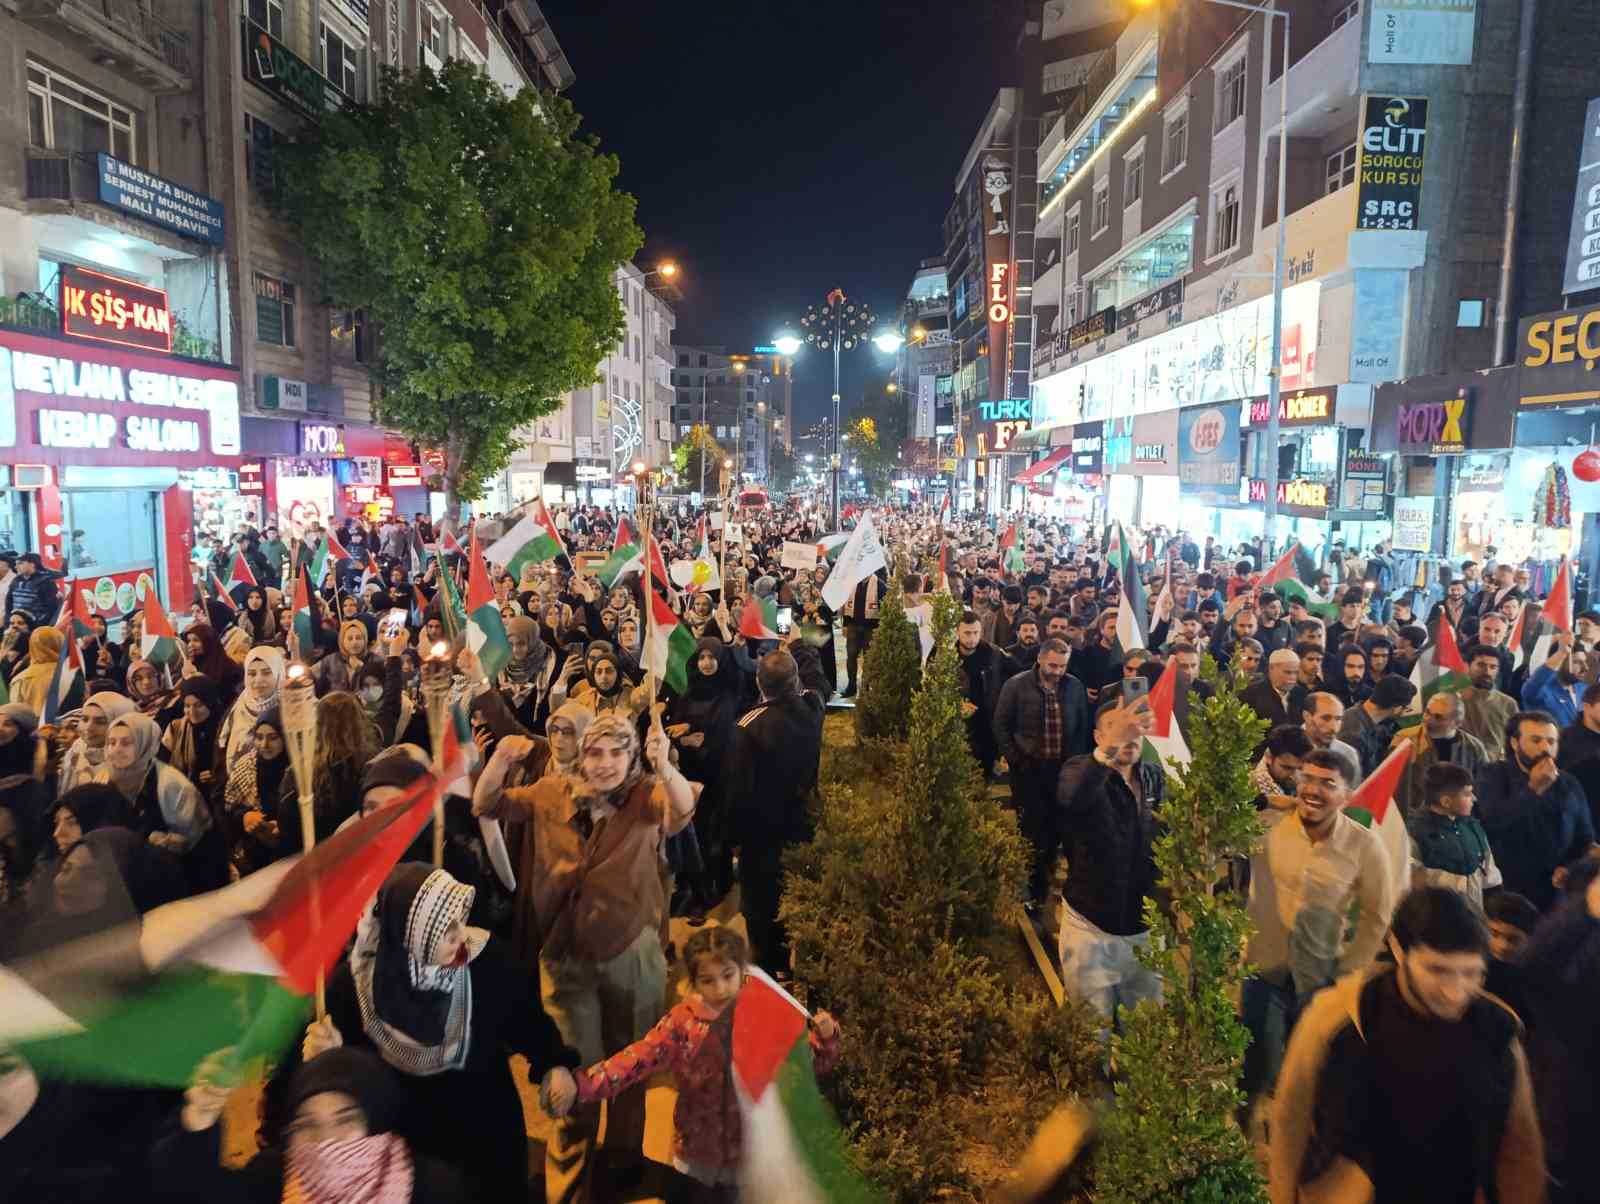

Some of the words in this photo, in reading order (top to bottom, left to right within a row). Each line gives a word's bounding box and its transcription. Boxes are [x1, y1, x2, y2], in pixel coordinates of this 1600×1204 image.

[104, 173, 155, 201] SERBEST
[118, 163, 171, 195] MUSTAFA
[1362, 170, 1421, 185] KURSU
[1365, 200, 1412, 217] SRC
[988, 263, 1009, 322] FLO
[1524, 311, 1600, 371] SEÇ
[1355, 358, 1372, 367] Mall
[39, 408, 117, 449] KEBAP
[1250, 482, 1284, 504] MAA
